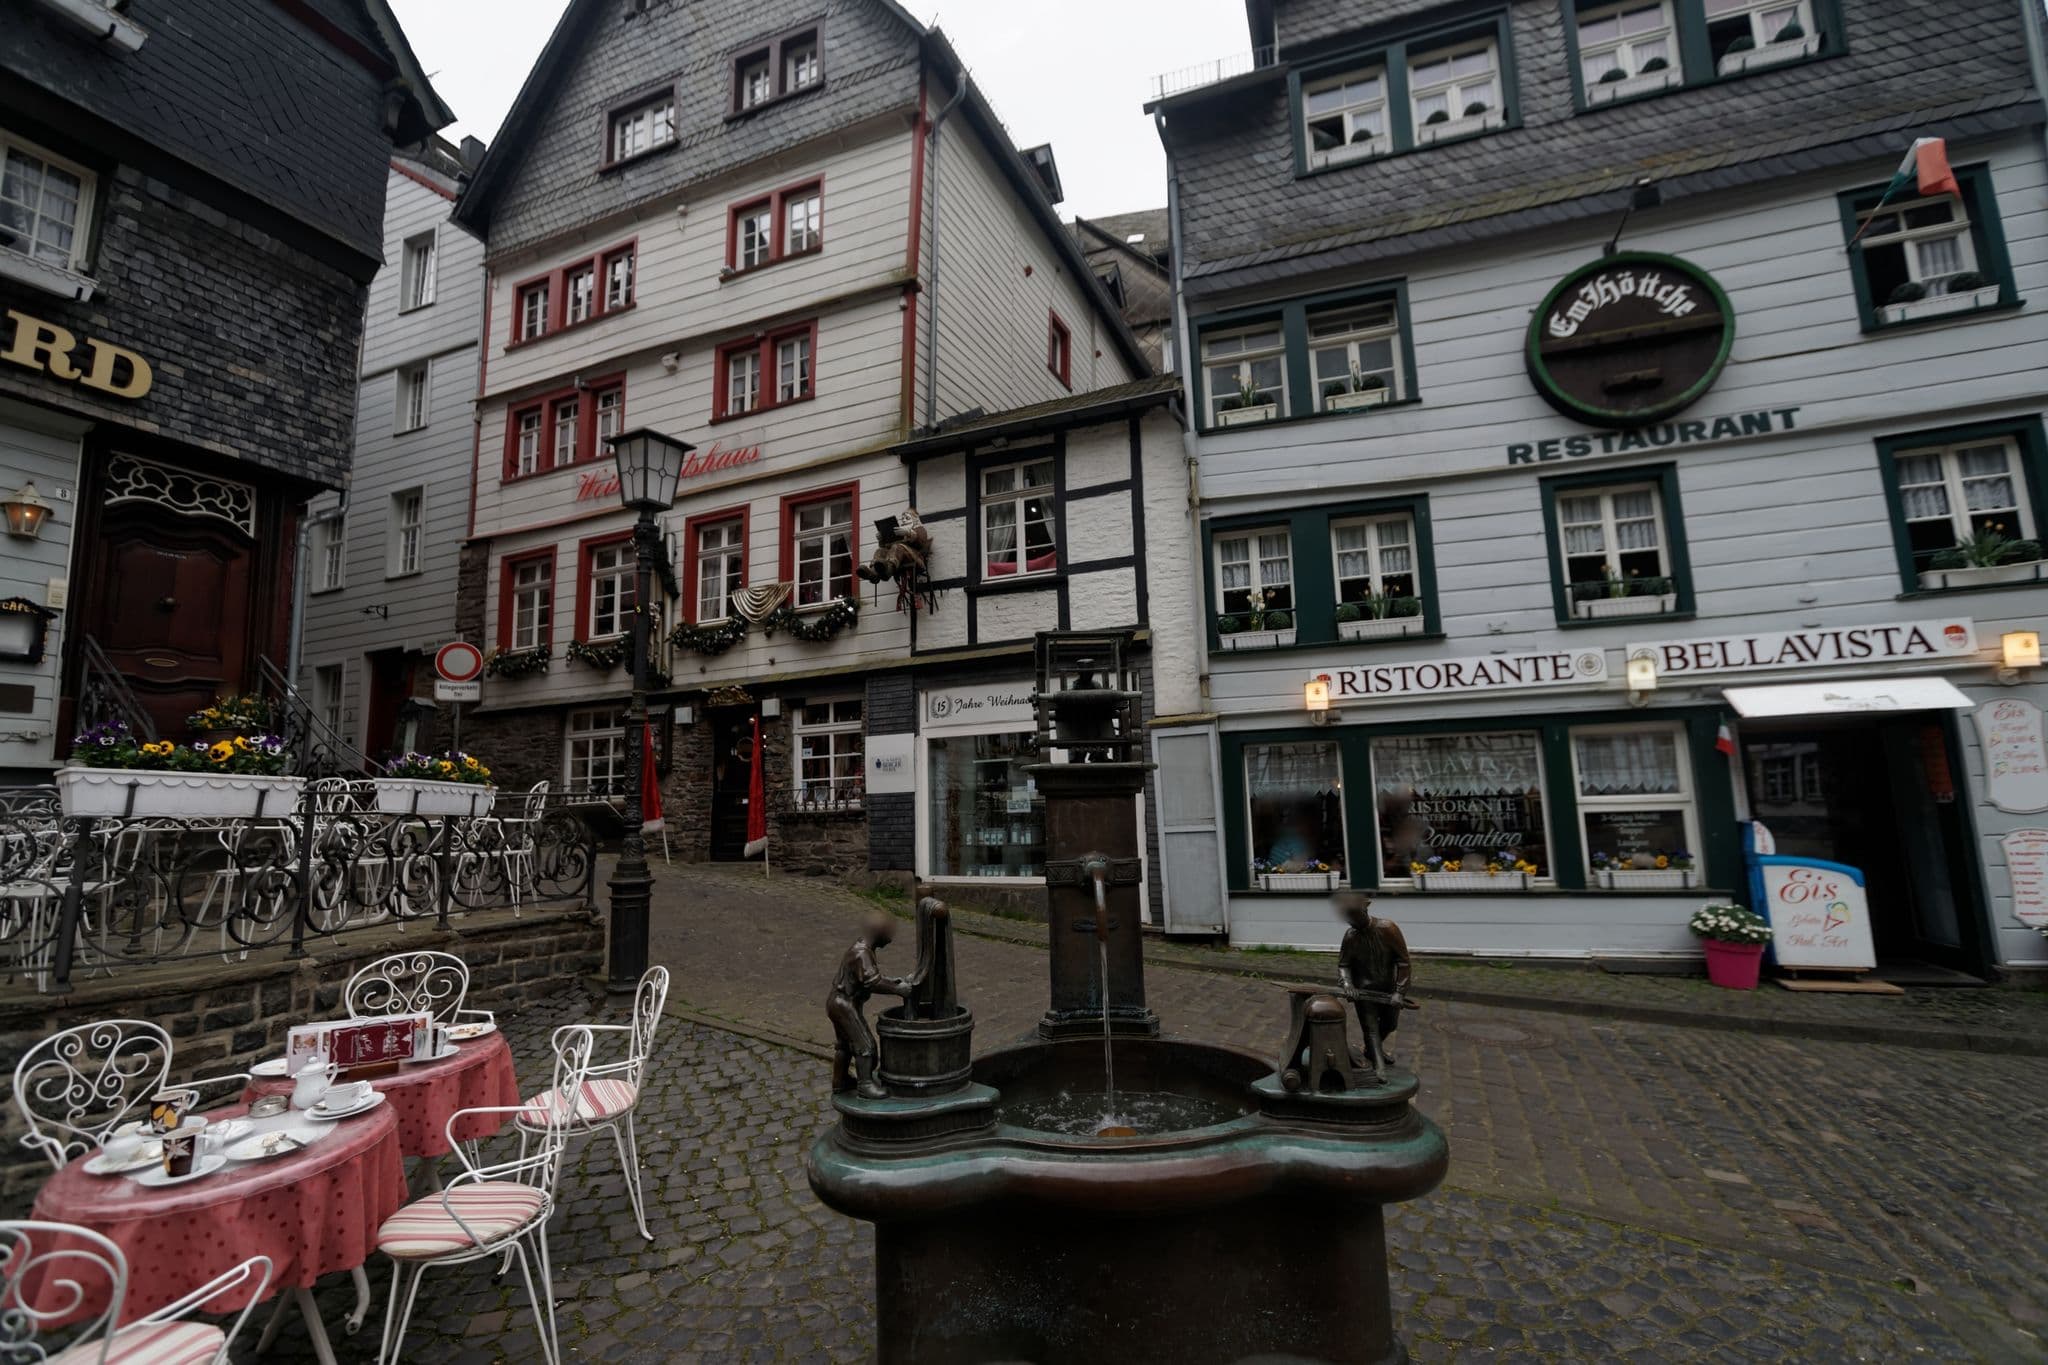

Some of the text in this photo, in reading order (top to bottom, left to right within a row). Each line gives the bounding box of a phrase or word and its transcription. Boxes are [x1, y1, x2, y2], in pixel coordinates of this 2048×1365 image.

[1507, 406, 1800, 465] RESTAURANT
[60, 489, 67, 499] 8
[1661, 626, 1938, 673] BELLAVISTA
[1337, 653, 1576, 695] RISTORANTE
[937, 700, 946, 712] 15
[954, 697, 983, 714] Jahre
[1780, 868, 1838, 904] Eis
